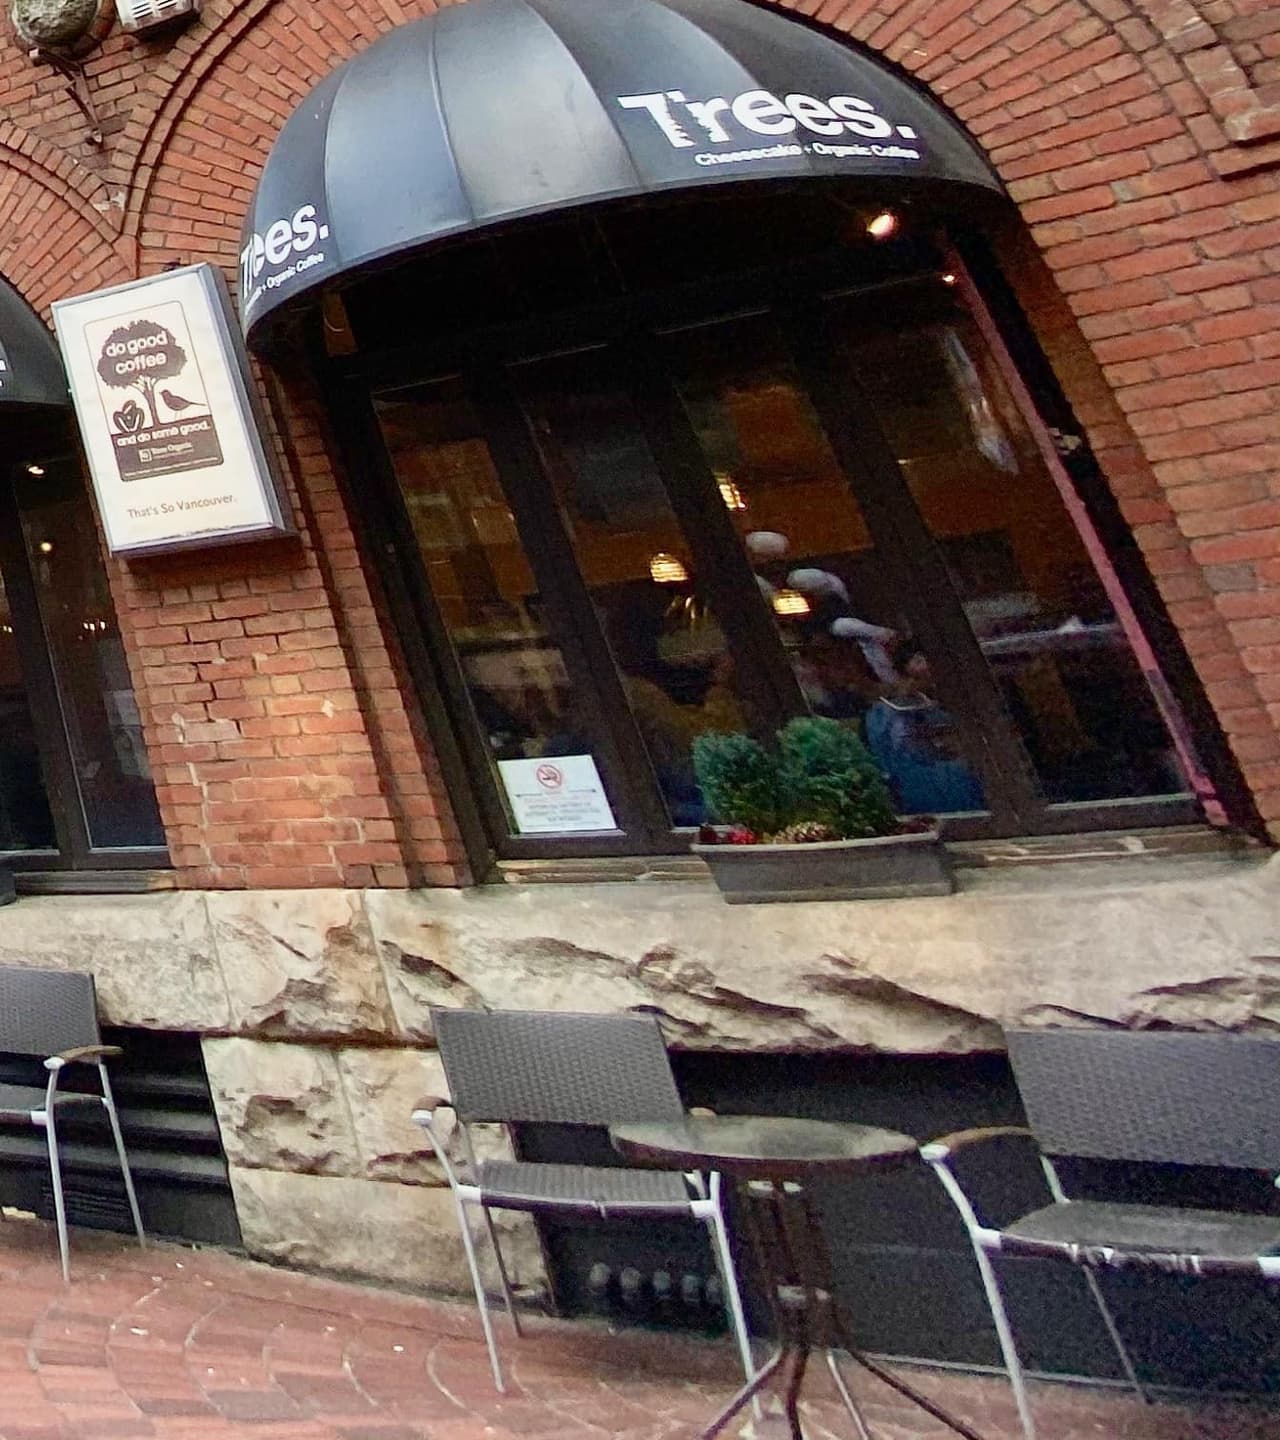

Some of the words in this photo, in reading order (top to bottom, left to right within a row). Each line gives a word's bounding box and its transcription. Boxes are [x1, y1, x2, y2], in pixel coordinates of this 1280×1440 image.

[617, 89, 919, 148] Trees.
[695, 144, 801, 167] Cheesecake
[813, 141, 871, 159] Organic
[872, 144, 920, 160] Coffee
[105, 337, 126, 357] do
[127, 330, 168, 355] good
[115, 351, 168, 375] coffee
[117, 433, 137, 447] and
[137, 431, 151, 443] do
[152, 425, 179, 440] some
[127, 505, 159, 520] That's
[161, 502, 175, 514] So
[176, 492, 238, 512] Vancouver.
